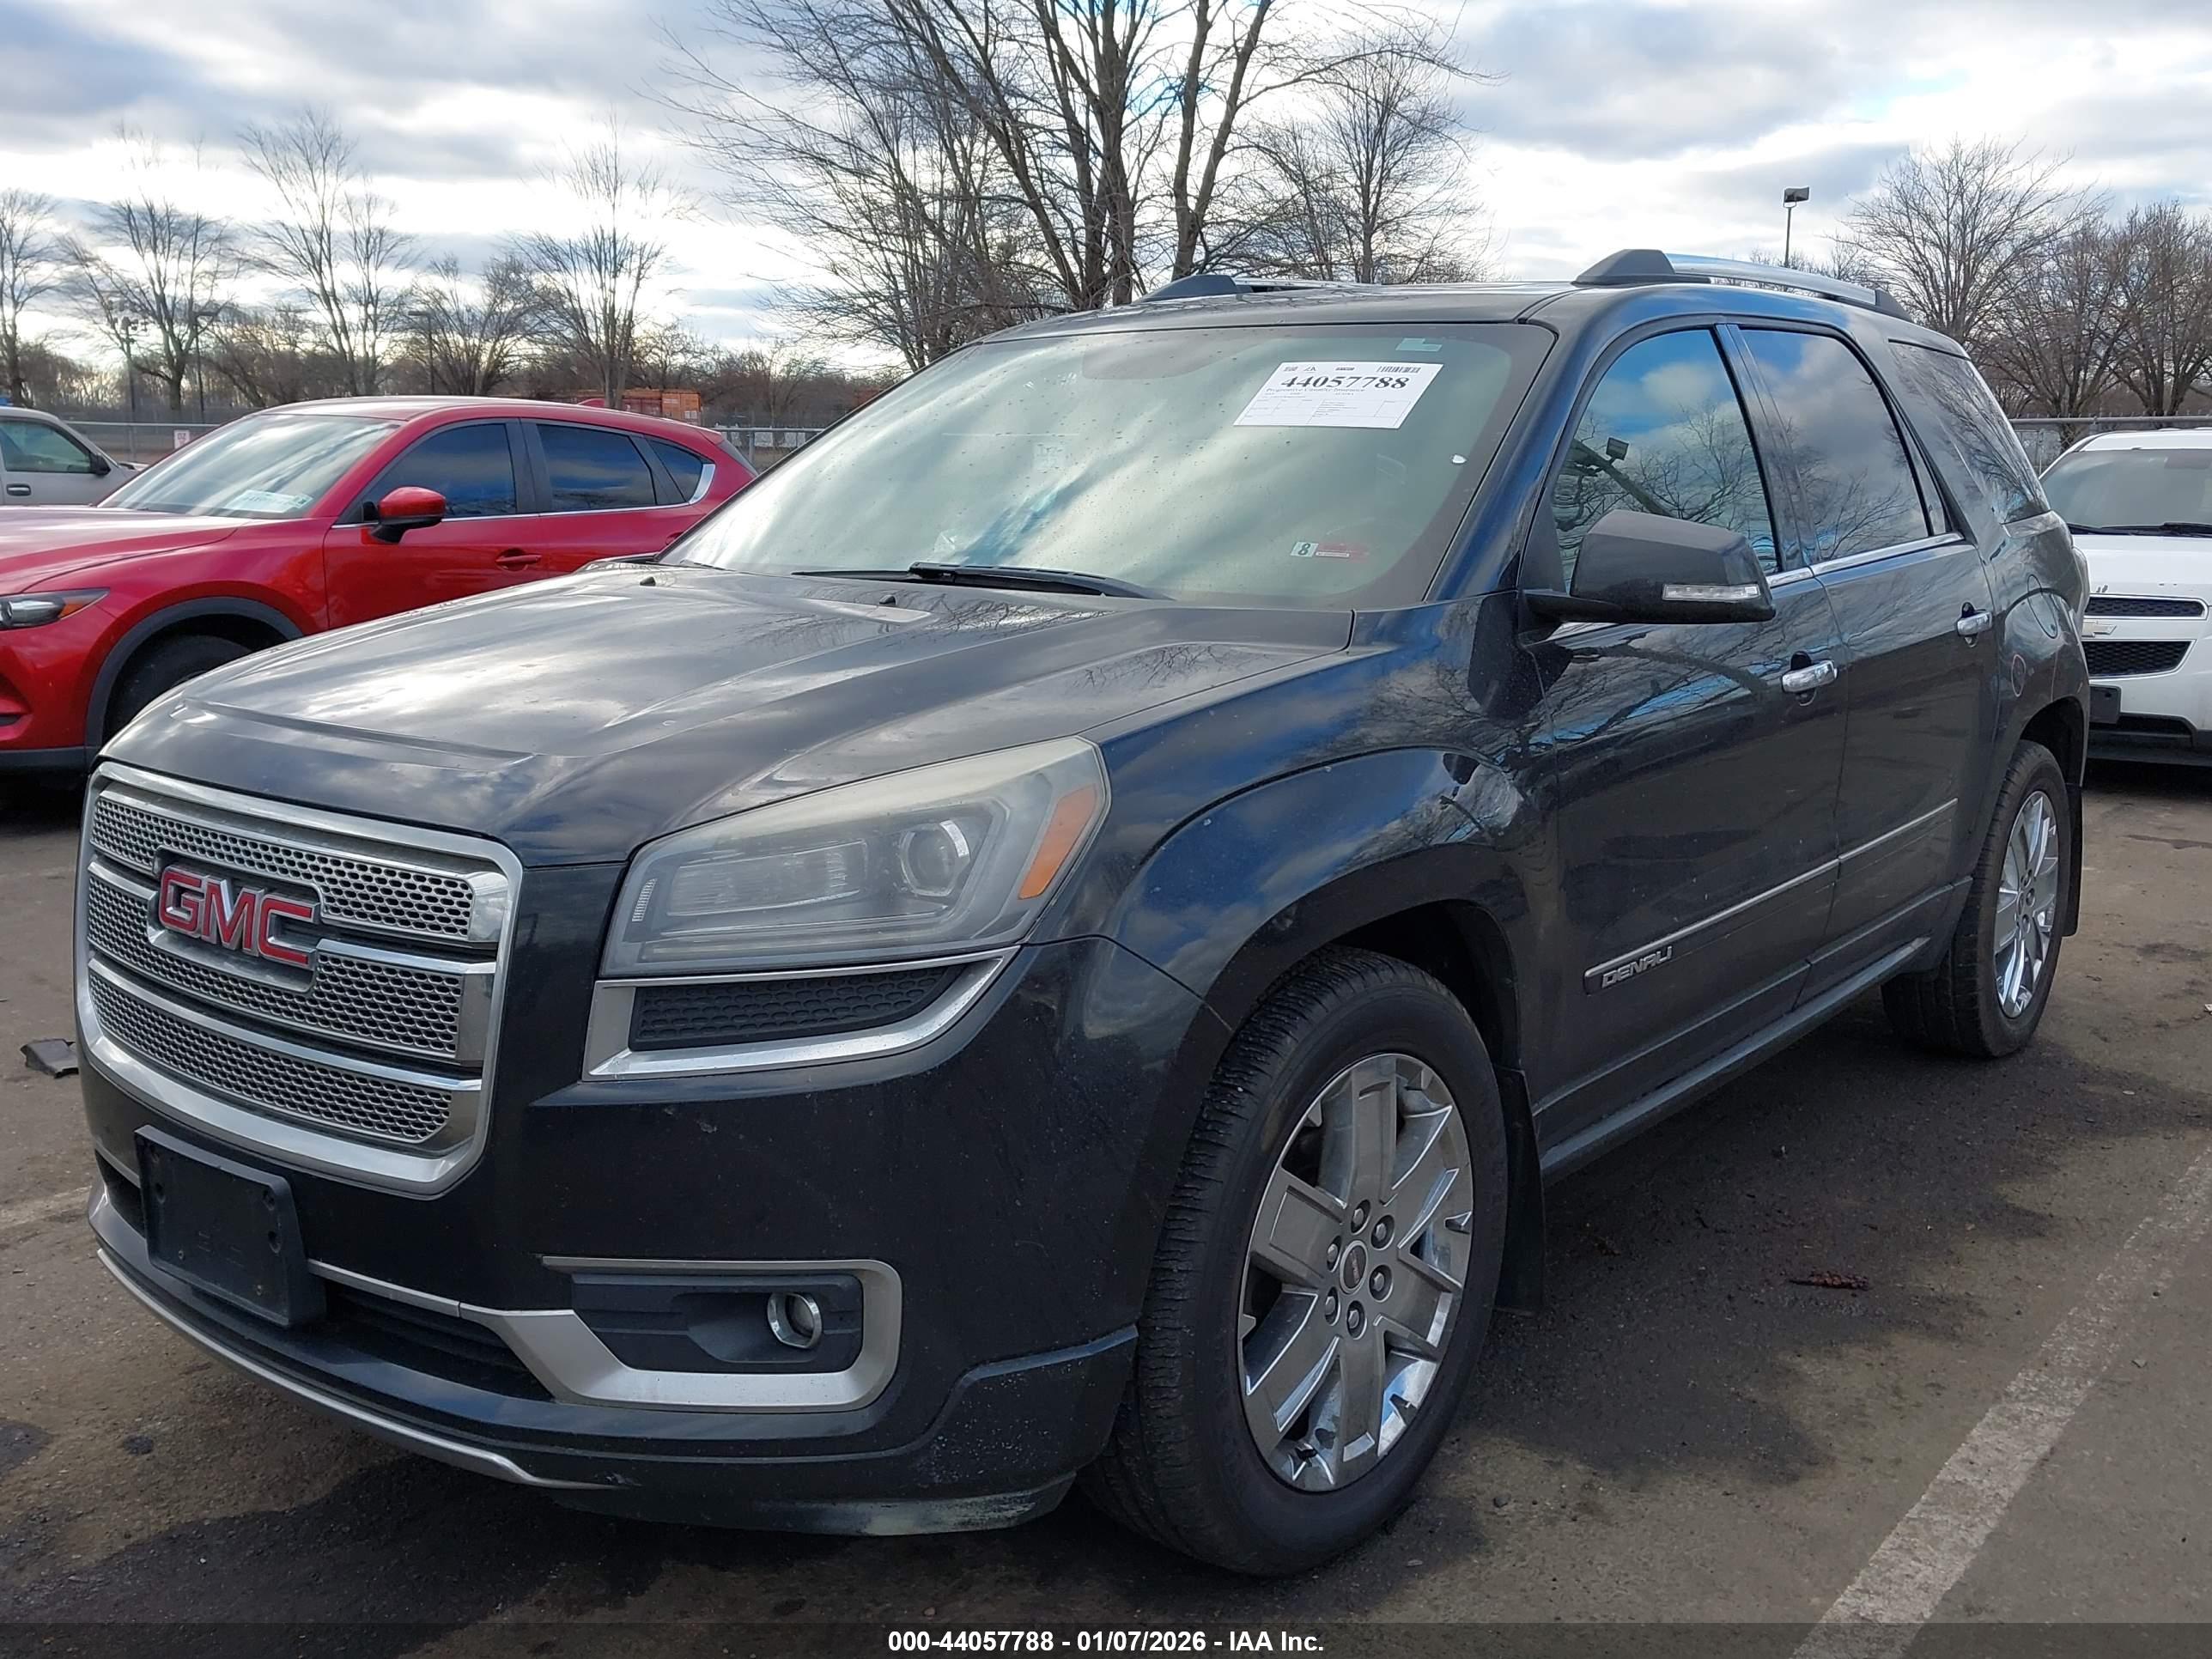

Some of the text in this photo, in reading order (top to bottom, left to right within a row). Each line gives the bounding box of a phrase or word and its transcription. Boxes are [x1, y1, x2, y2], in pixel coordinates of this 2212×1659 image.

[1281, 376, 1409, 388] 44057788
[1297, 543, 1310, 556] 8
[159, 866, 320, 970] GMC
[1601, 945, 1672, 988] DENALI
